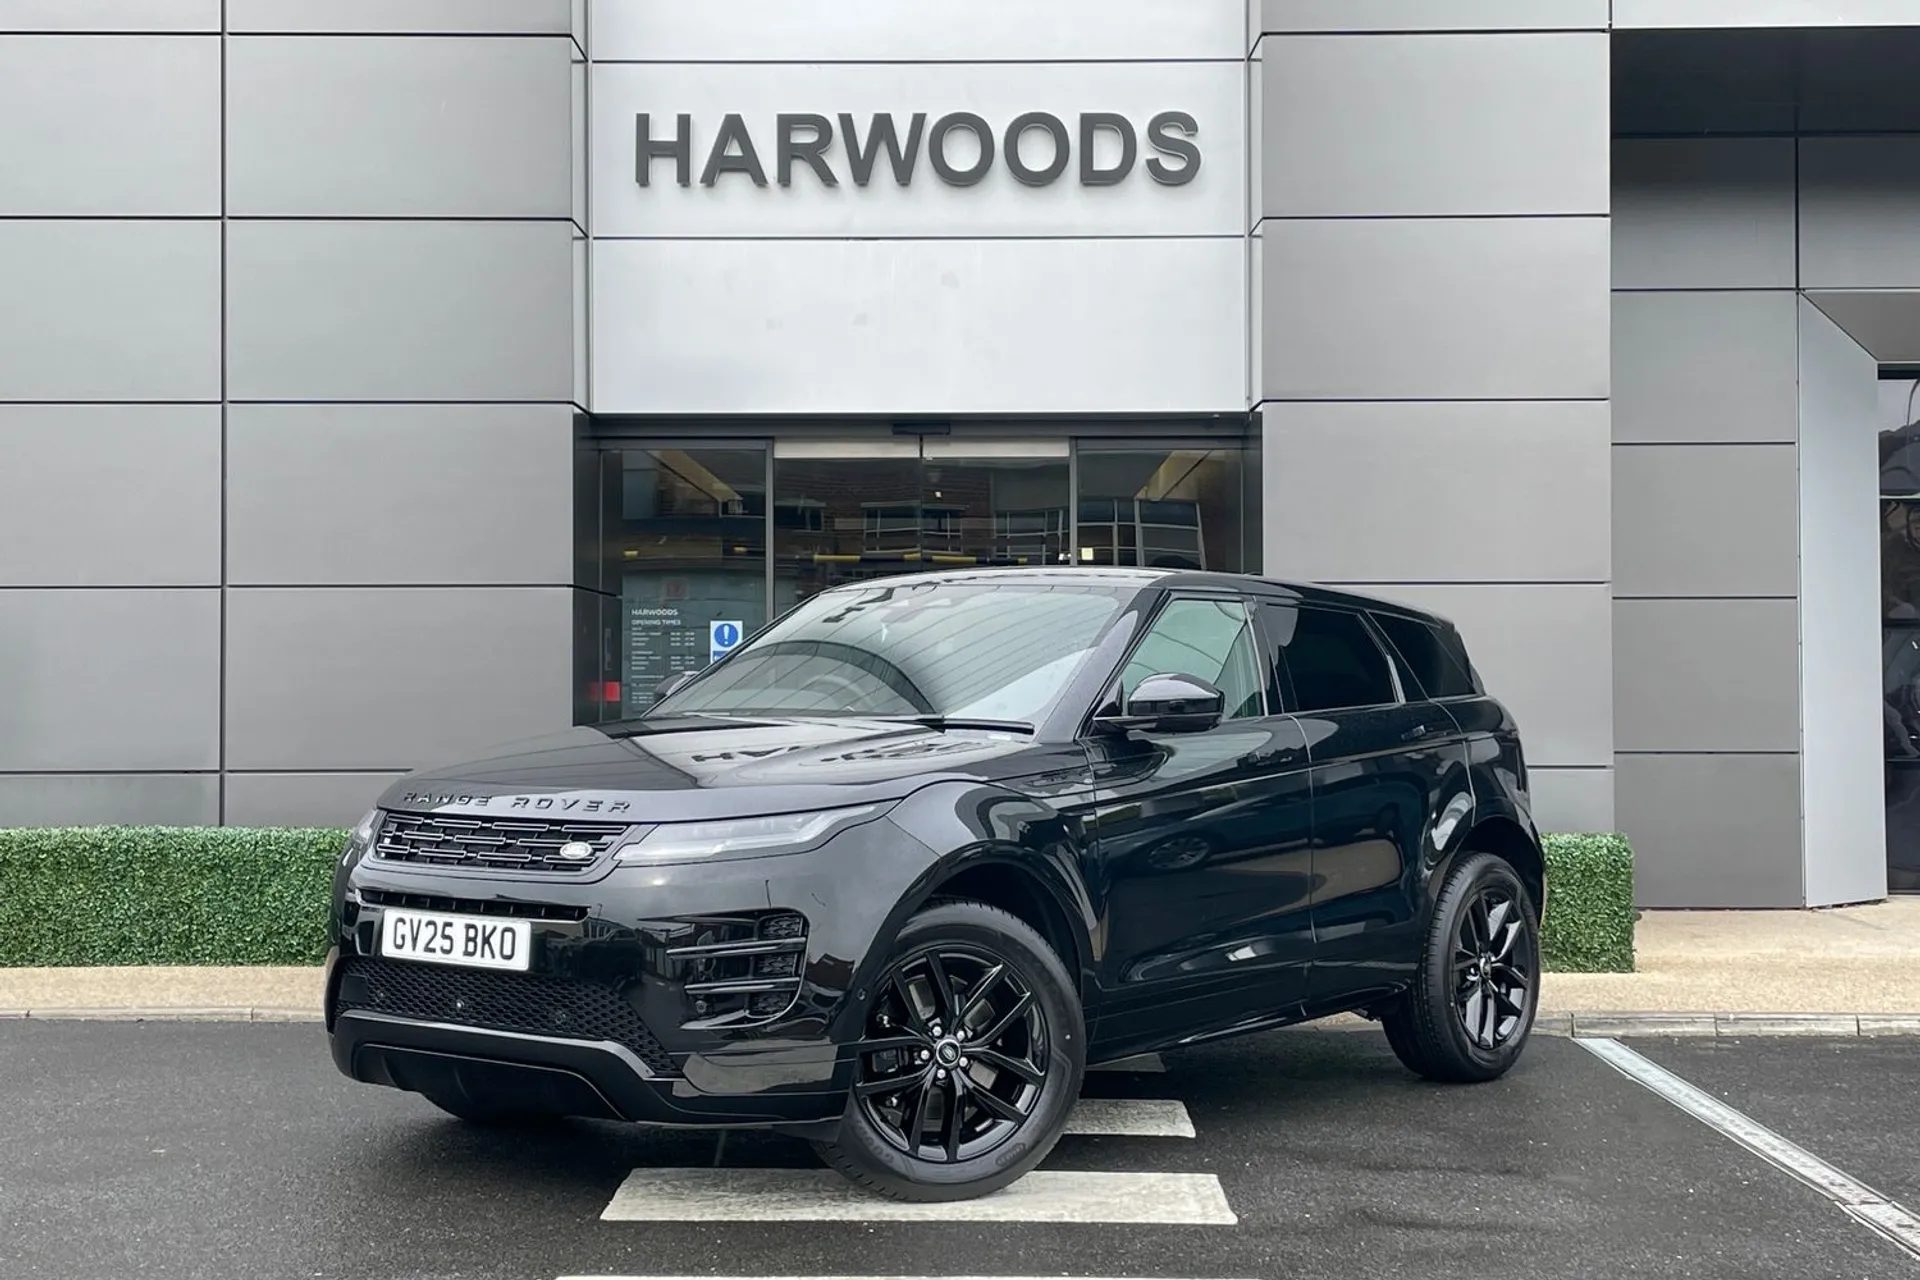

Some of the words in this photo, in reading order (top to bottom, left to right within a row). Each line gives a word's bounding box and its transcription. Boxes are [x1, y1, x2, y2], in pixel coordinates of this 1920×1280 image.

[635, 112, 1201, 186] HARWOODS
[403, 791, 492, 807] RANGE
[511, 796, 632, 814] ROVER
[393, 917, 454, 955] GV25
[462, 923, 517, 961] BKO
